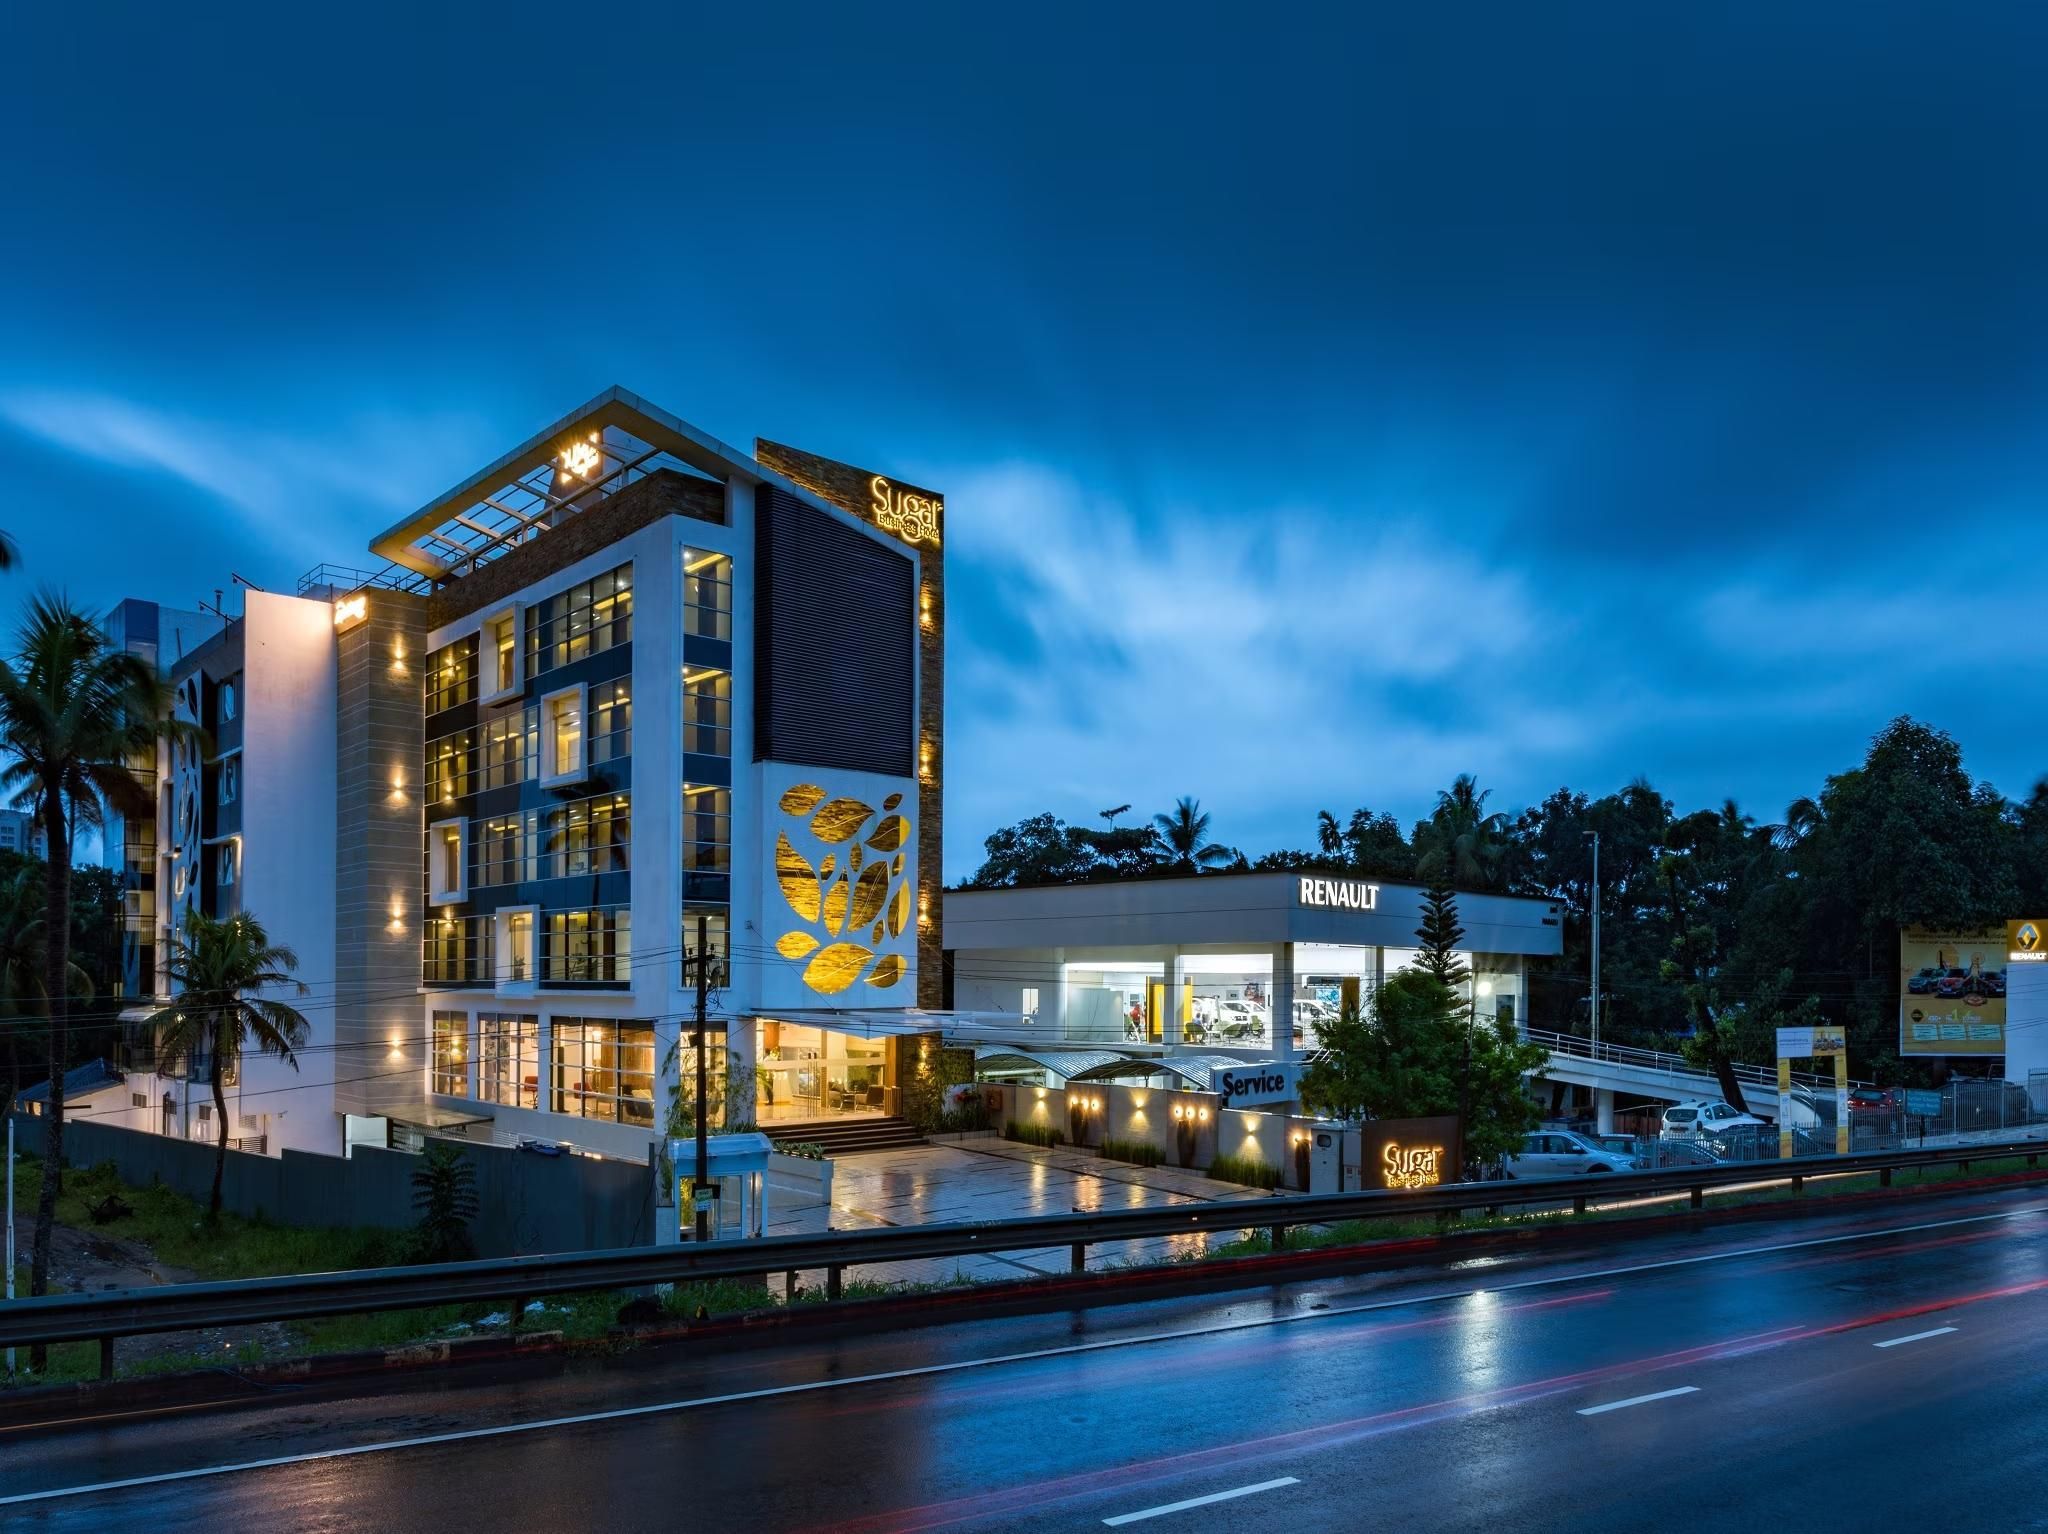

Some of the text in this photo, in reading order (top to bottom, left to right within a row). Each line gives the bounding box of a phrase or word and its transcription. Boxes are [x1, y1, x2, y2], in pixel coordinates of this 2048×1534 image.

[872, 476, 944, 543] Sugar
[1300, 877, 1380, 910] RENAULT
[2009, 951, 2047, 961] RENAULT
[1222, 1069, 1285, 1097] Service
[1384, 1143, 1444, 1188] Sugar
